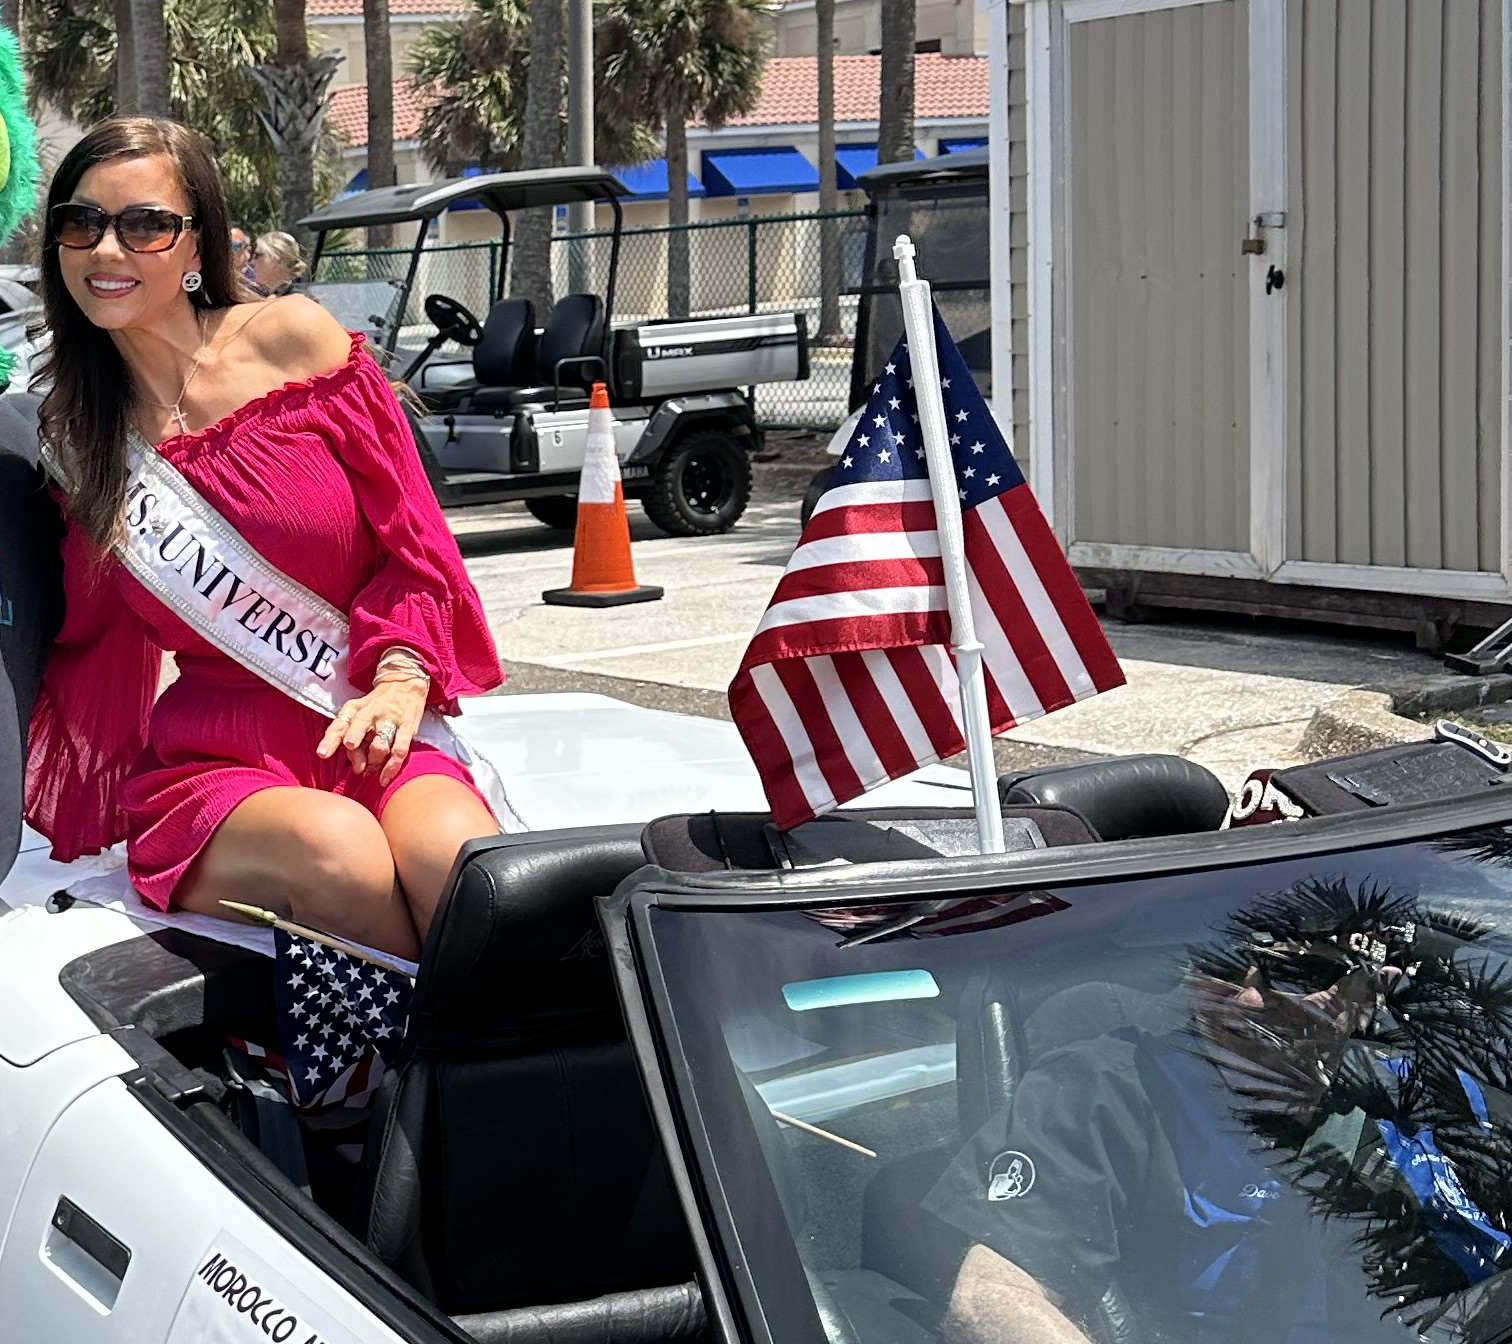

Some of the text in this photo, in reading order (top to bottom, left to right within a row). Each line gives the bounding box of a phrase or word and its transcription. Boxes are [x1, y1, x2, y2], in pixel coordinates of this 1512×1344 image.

[159, 521, 340, 682] UNIVERSE
[1239, 1182, 1281, 1200] Dave
[198, 1253, 297, 1343] MOROCCO
